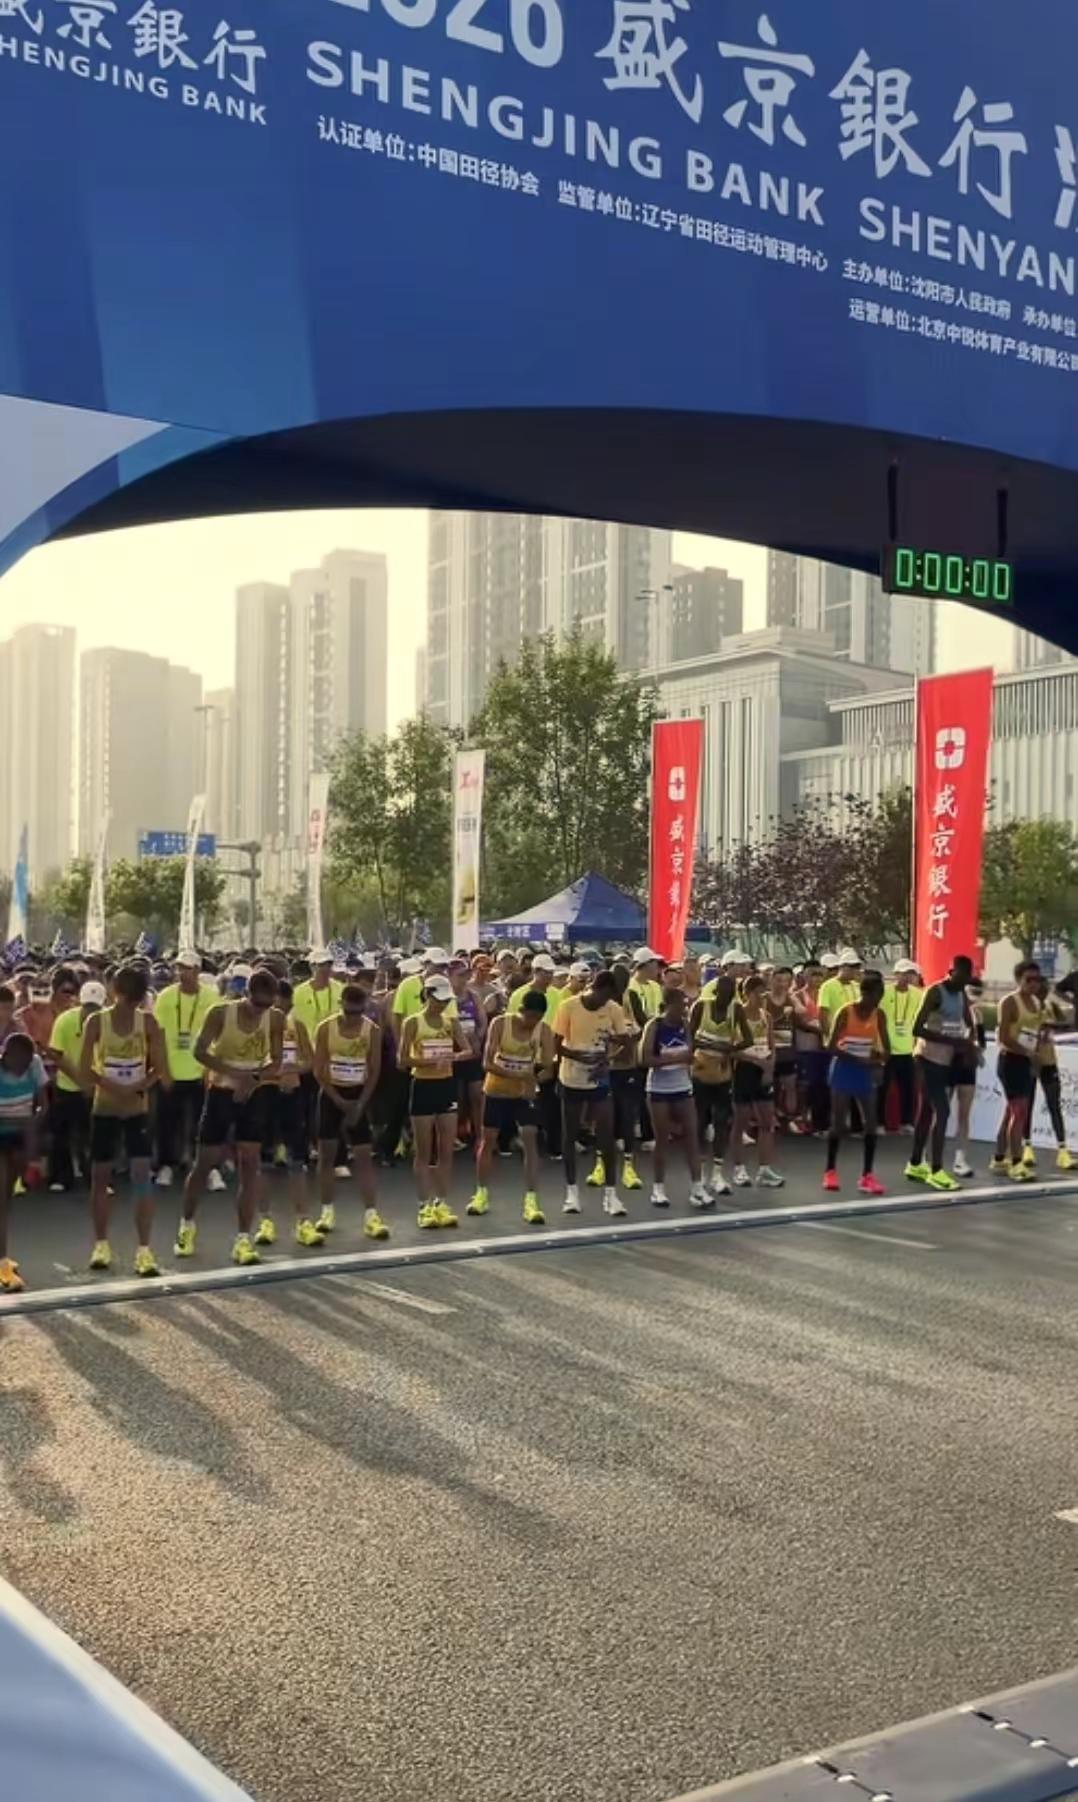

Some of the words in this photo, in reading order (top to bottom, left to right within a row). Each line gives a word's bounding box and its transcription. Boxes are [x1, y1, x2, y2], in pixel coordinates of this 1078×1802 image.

[329, 0, 564, 67] 26
[182, 86, 267, 125] BANK
[306, 41, 662, 180] SHENGJING
[686, 150, 825, 225] BANK
[896, 548, 1010, 600] 0:00:00
